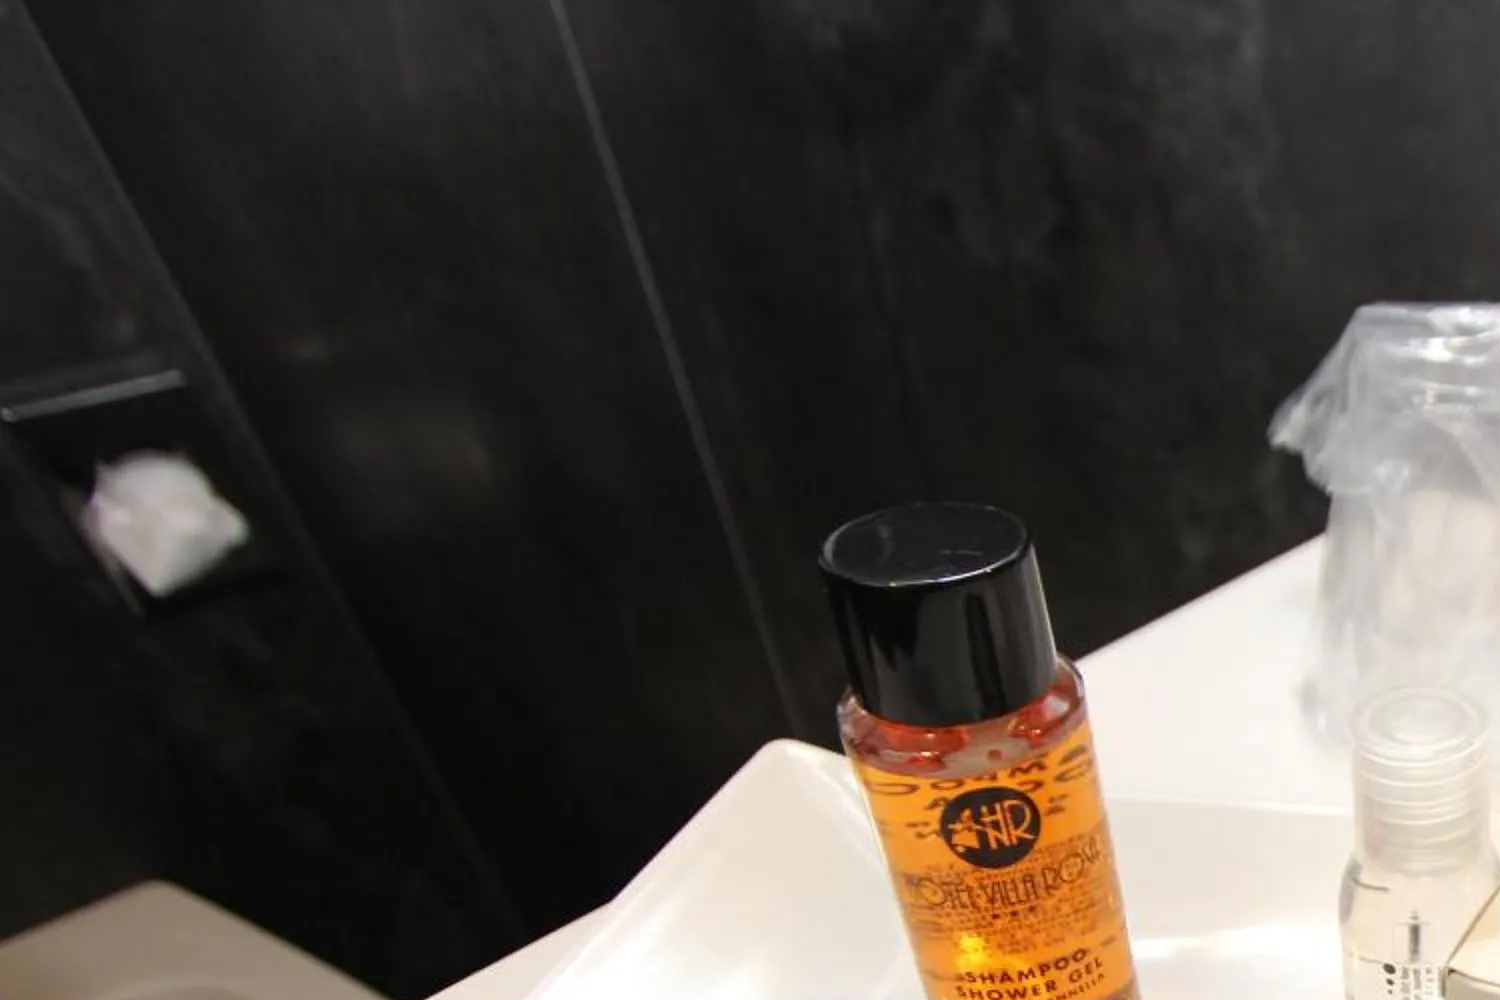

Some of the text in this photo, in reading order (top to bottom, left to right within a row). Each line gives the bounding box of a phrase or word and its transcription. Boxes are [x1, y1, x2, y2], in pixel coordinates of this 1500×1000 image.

[908, 876, 978, 911] OTEL
[963, 947, 1088, 985] SHAMPOO
[1068, 958, 1103, 984] GEL
